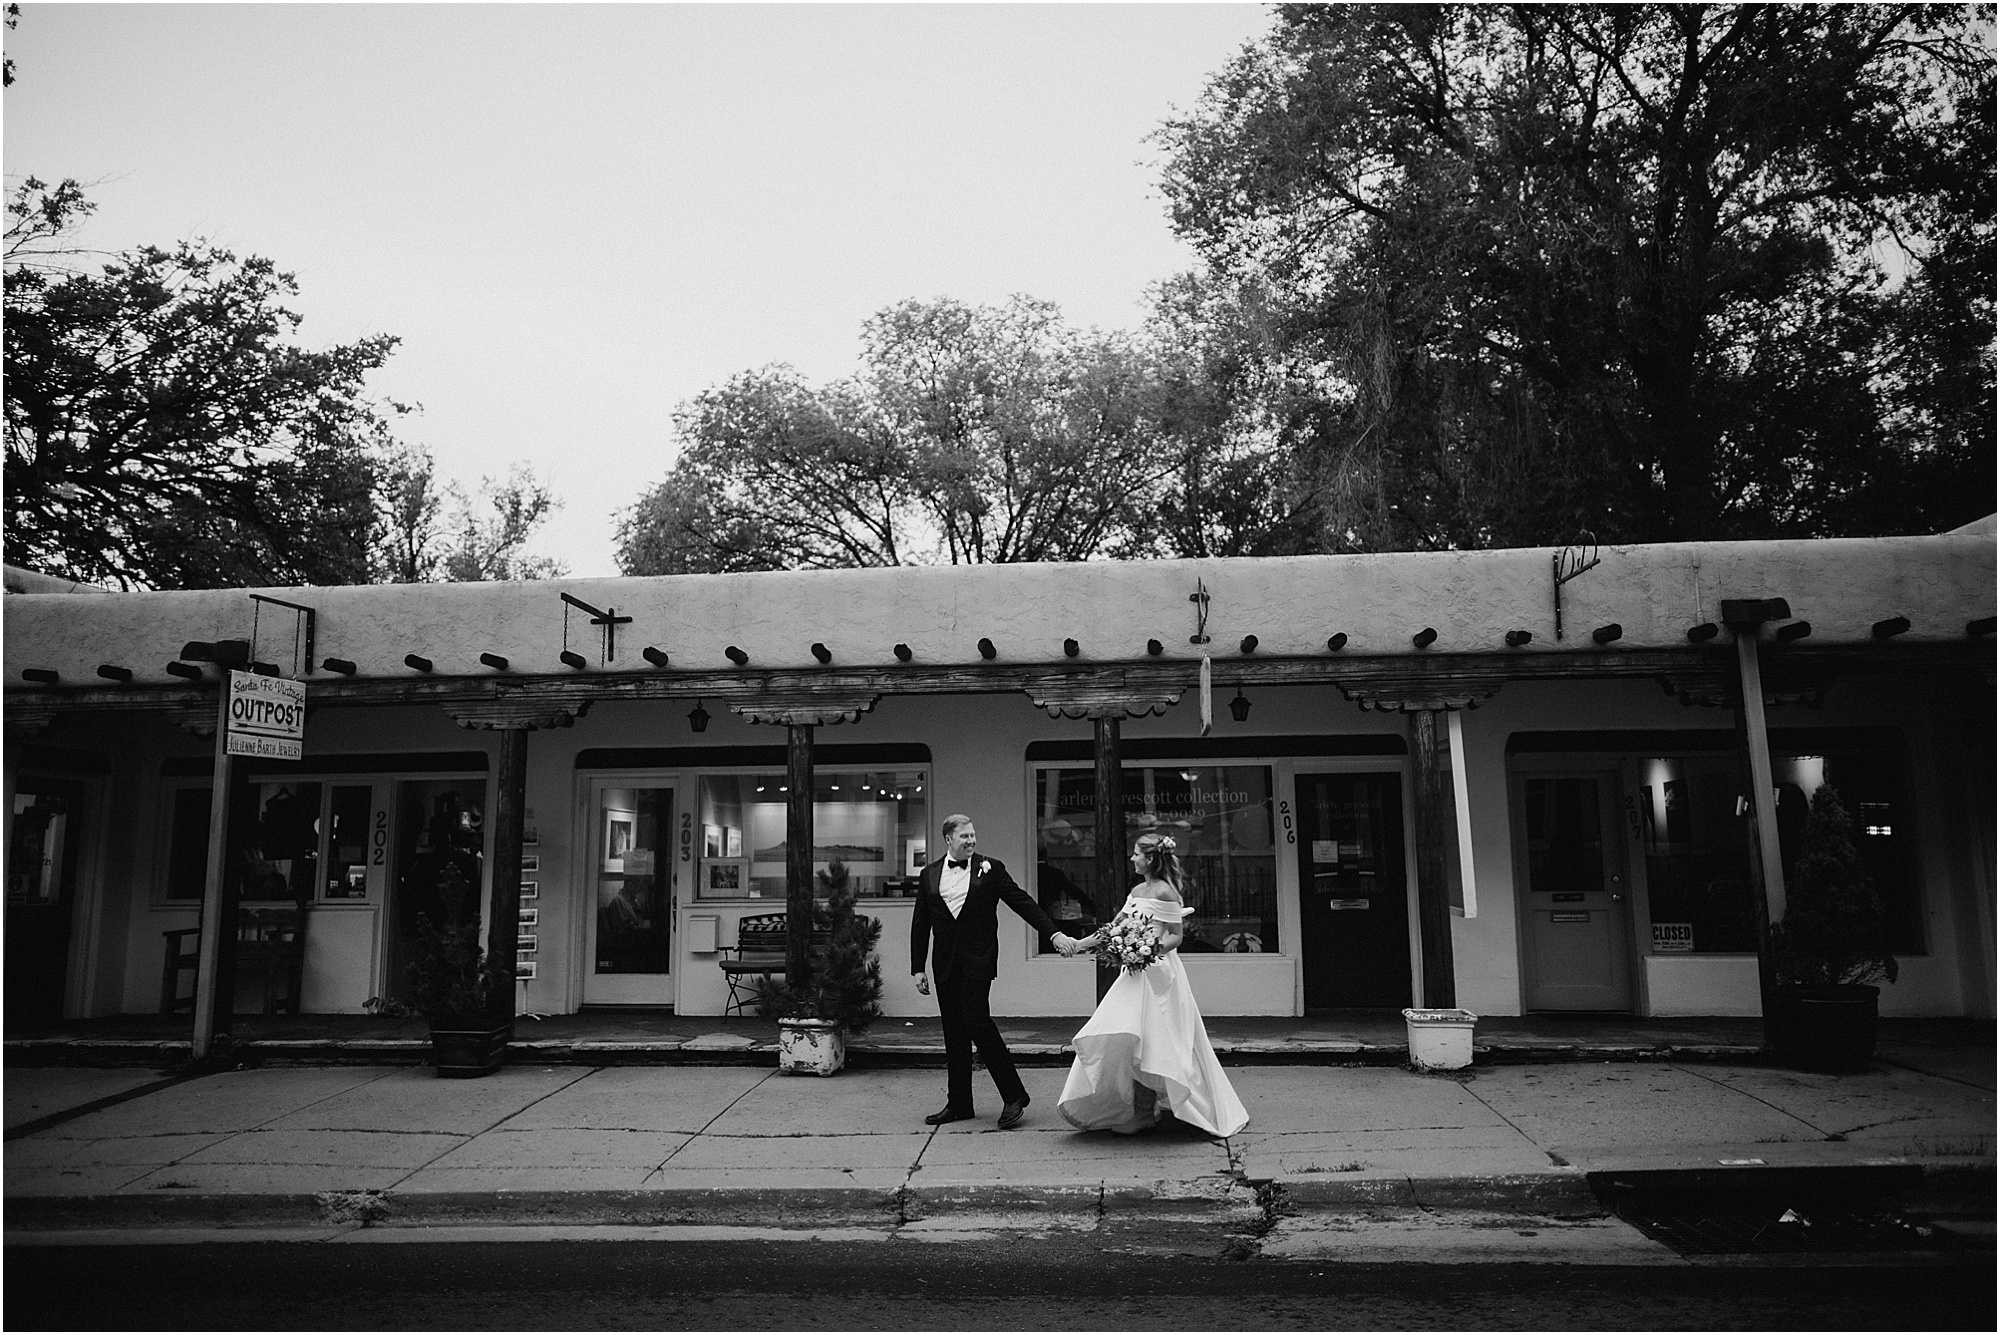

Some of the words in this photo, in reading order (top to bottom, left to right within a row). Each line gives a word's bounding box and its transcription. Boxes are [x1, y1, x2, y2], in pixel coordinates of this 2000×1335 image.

[234, 679, 258, 693] Santa
[260, 679, 273, 691] Fe
[274, 681, 304, 705] Vintage
[232, 697, 303, 727] OUTPOST
[1060, 790, 1096, 806] arlen
[1121, 790, 1171, 805] rescott
[1175, 788, 1249, 804] collection
[1279, 801, 1295, 844] 206
[1625, 795, 1641, 839] 207
[373, 811, 388, 866] 202
[681, 812, 692, 862] 203
[1652, 925, 1691, 941] CLOSED
